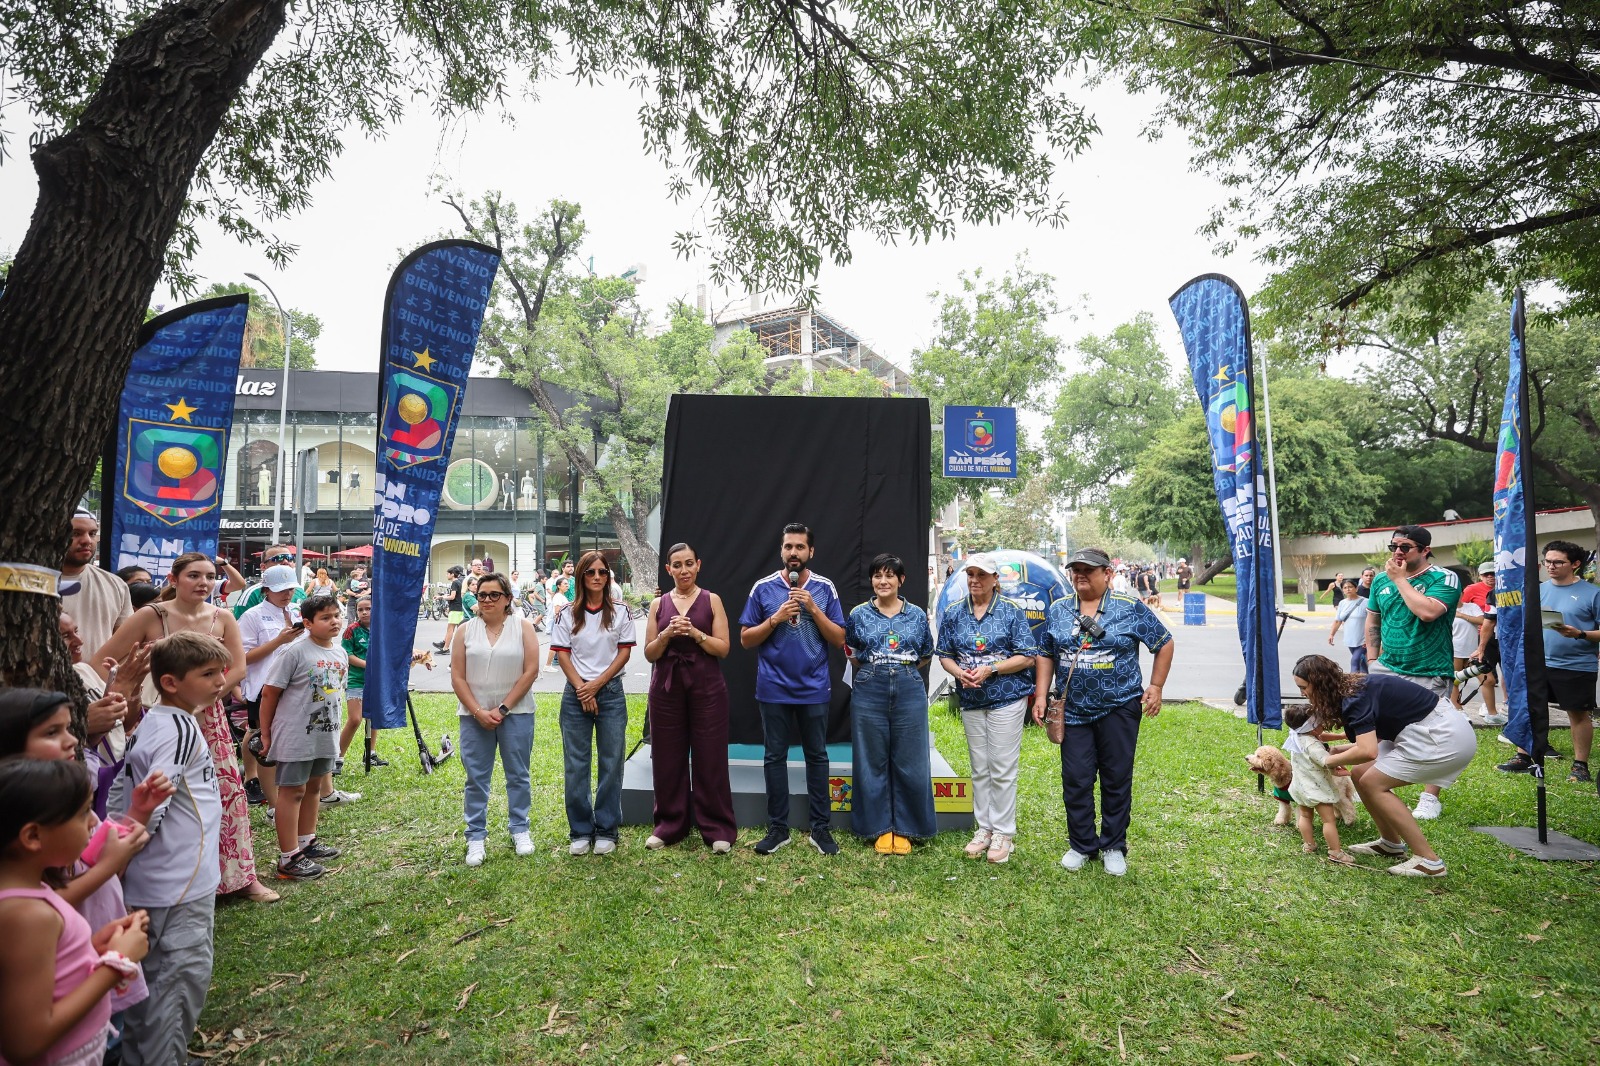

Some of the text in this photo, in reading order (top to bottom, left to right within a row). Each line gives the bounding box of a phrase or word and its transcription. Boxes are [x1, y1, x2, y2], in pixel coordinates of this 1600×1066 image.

[138, 374, 235, 393] BIENVENIDO
[949, 456, 1011, 465] SAN PEDRO
[383, 536, 420, 557] UNDIAL
